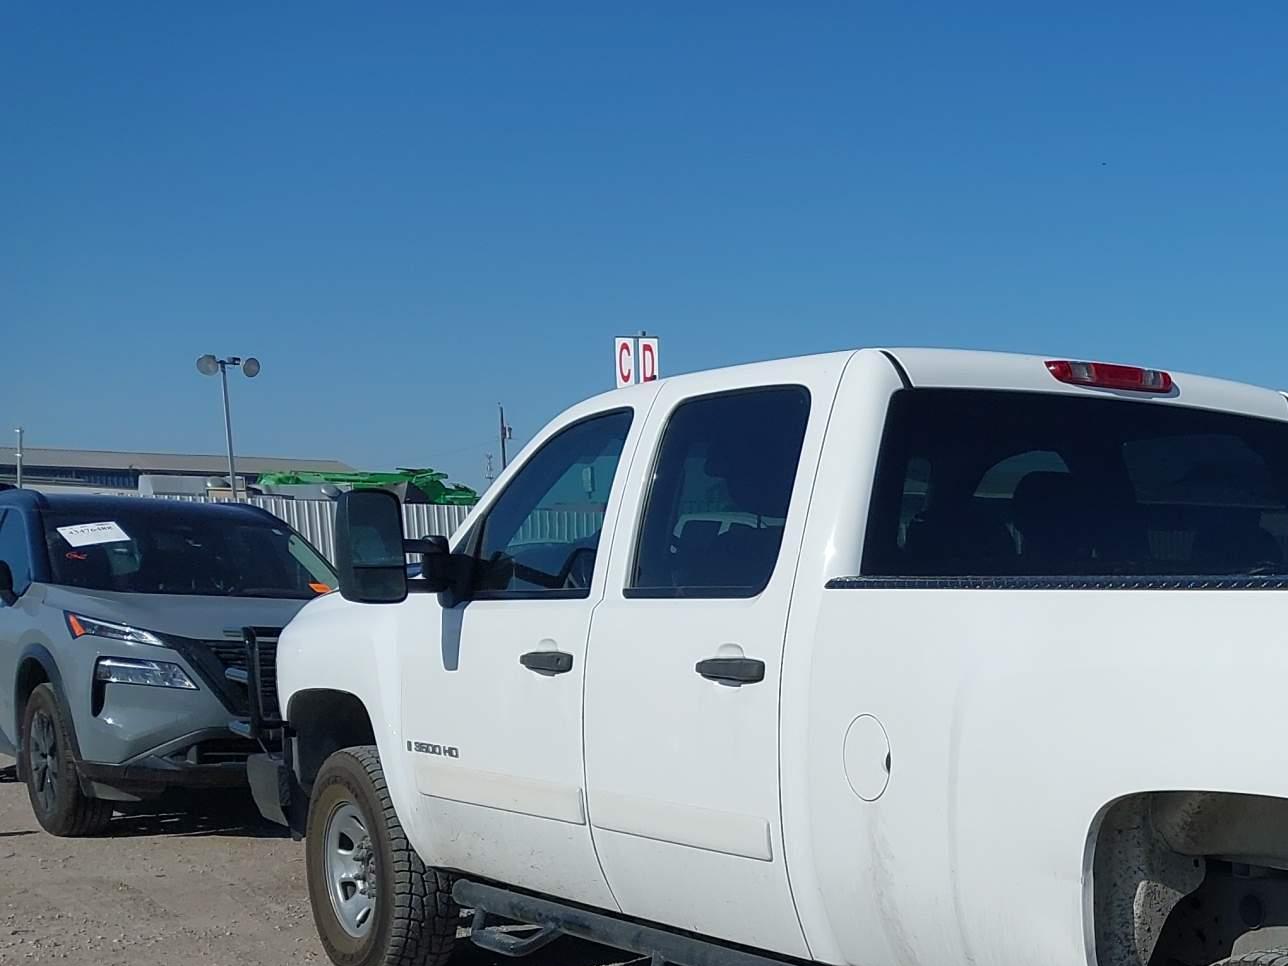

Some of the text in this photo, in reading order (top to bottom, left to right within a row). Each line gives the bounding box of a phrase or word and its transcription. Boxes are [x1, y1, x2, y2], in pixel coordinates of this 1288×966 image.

[619, 342, 631, 383] C
[643, 344, 656, 382] D
[414, 741, 459, 758] 3500 HD
